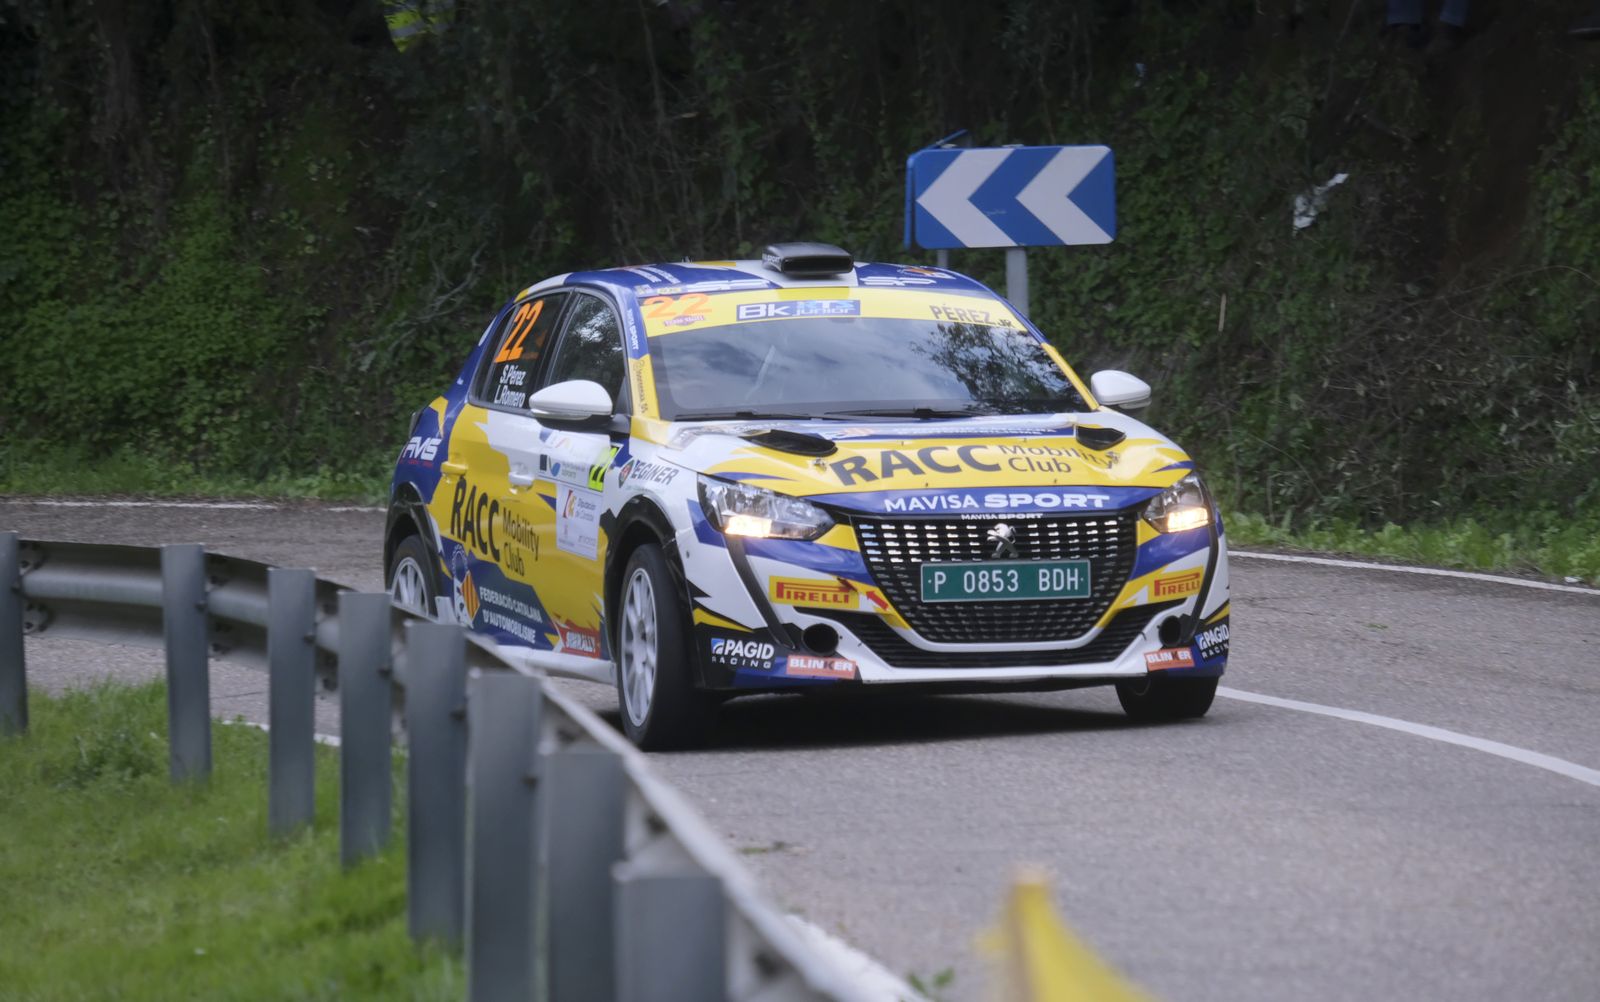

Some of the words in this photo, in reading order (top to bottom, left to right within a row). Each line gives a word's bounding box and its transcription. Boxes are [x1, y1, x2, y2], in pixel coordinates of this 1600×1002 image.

[643, 293, 713, 319] 22
[929, 303, 996, 325] PÉREZ
[494, 300, 544, 364] 22
[829, 445, 1002, 486] RACC
[995, 444, 1113, 469] Mobility
[1008, 457, 1072, 473] Club
[883, 494, 983, 513] MAVISA
[984, 493, 1110, 508] SPORT
[451, 474, 500, 562] RACC
[503, 507, 539, 562] Mobility
[998, 512, 1043, 520] SPORT
[503, 542, 525, 576] Club
[776, 581, 856, 604] PIRELLI
[933, 571, 947, 594] P
[963, 569, 1019, 592] 0853
[1038, 568, 1079, 591] BDH
[1154, 572, 1201, 597] PIRELLI
[479, 586, 513, 611] FEDERACIÓ
[1202, 624, 1230, 649] PAGID
[724, 639, 775, 660] PAGID
[711, 656, 772, 669] RACING
[789, 658, 853, 672] BLINKER
